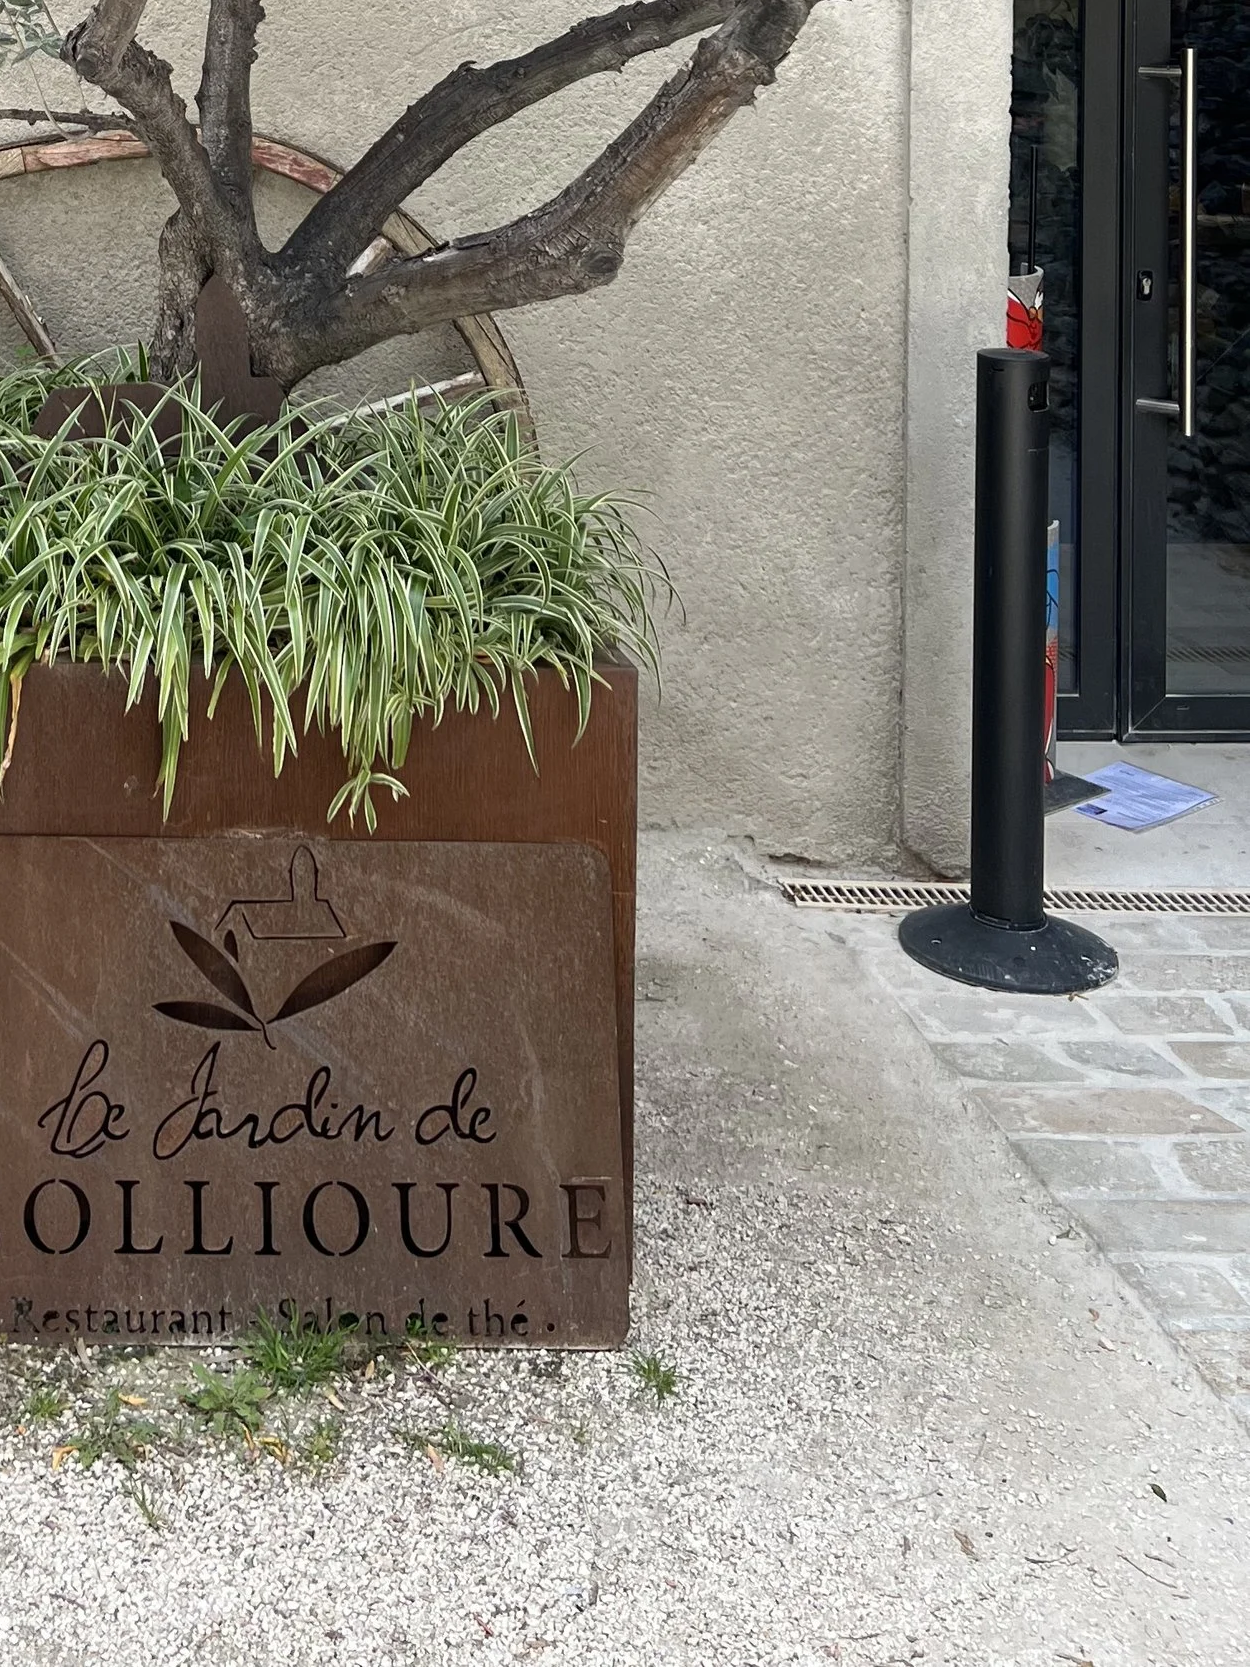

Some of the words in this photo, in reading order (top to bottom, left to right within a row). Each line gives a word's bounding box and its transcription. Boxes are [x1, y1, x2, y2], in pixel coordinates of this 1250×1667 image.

[38, 1039, 130, 1158] Le
[153, 1041, 395, 1160] Jardin
[415, 1066, 497, 1145] de
[11, 1296, 233, 1334] Restaurant
[278, 1297, 388, 1335] Salon
[405, 1297, 449, 1336] de
[467, 1298, 529, 1337] thé
